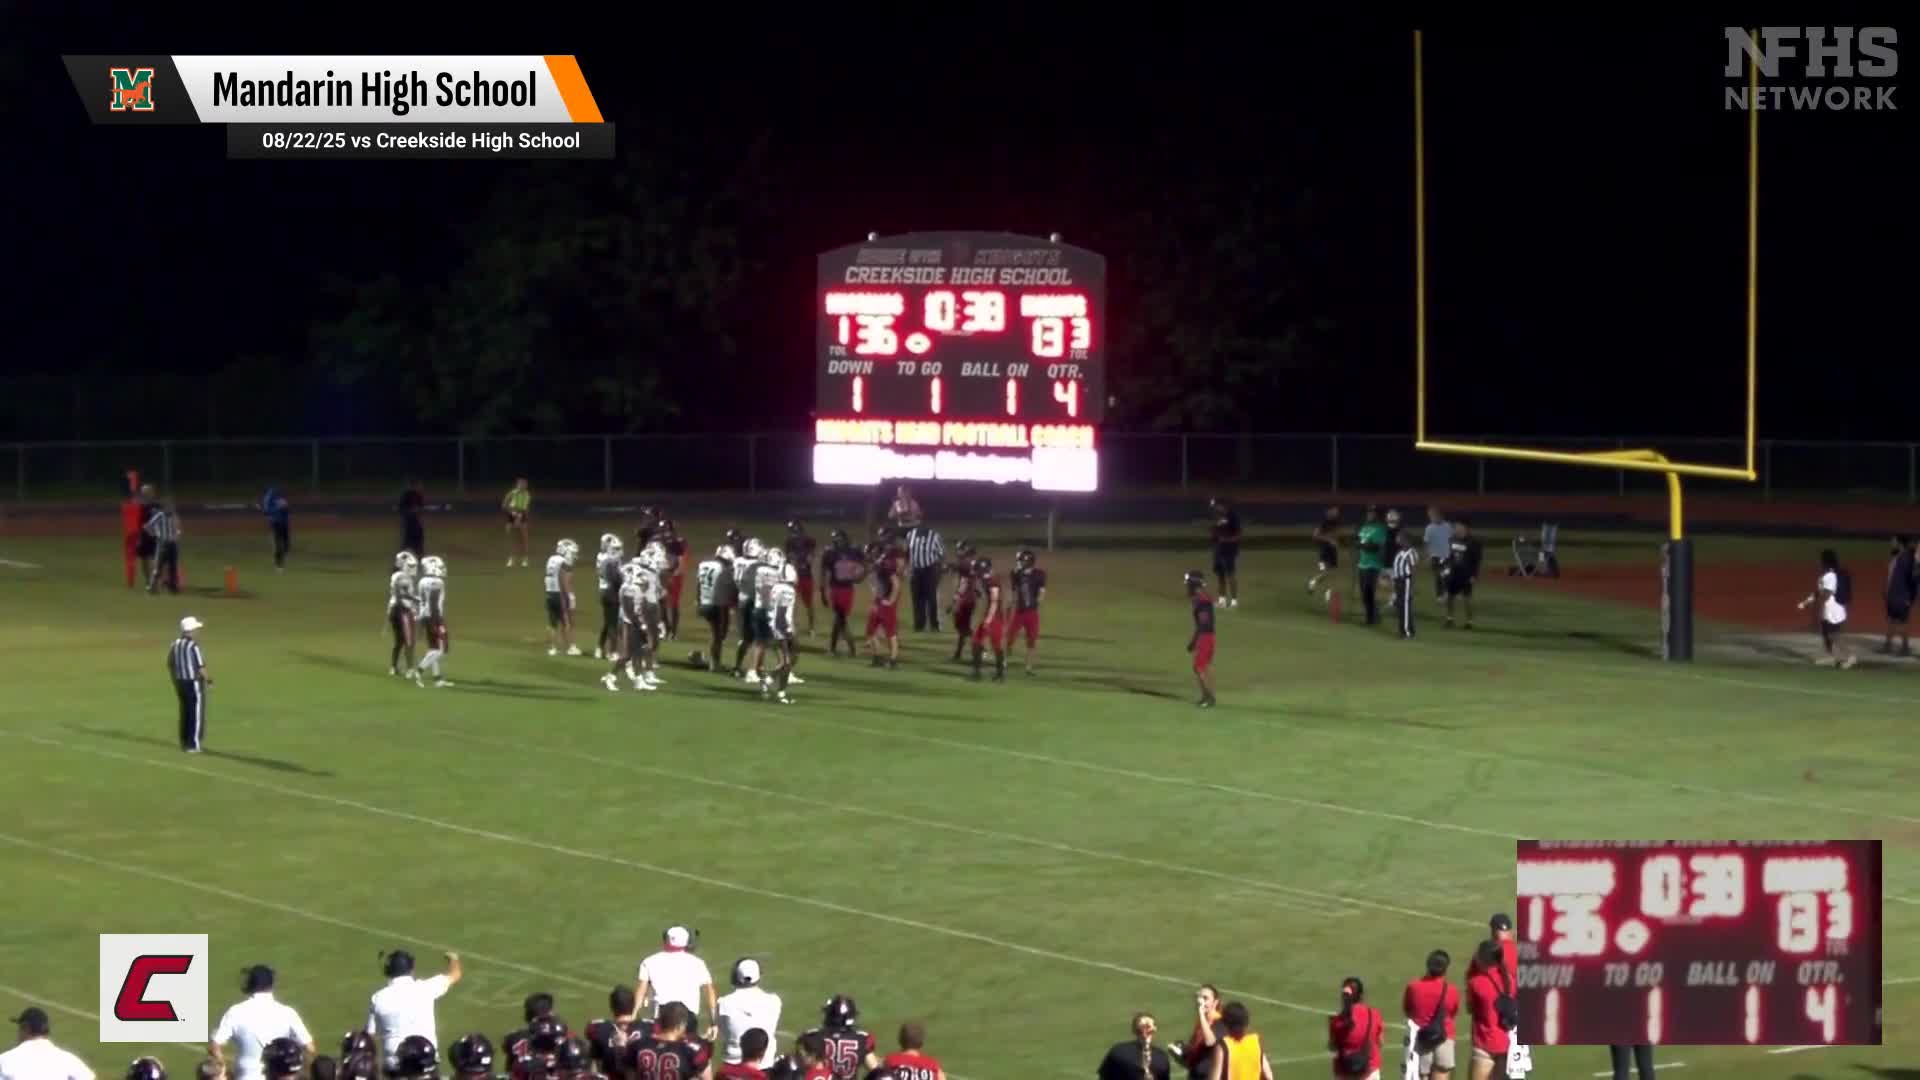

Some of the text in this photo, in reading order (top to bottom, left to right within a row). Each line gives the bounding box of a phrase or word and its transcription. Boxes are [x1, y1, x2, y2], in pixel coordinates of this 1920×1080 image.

[845, 267, 1072, 285] CREEKSIDE HIGH SCHOOL
[828, 362, 872, 374] DOWN
[898, 362, 942, 375] TO GO
[961, 362, 1028, 377] BALL ON
[1048, 364, 1083, 378] QTR.
[853, 376, 862, 412] 1
[932, 376, 941, 414] 1
[1007, 378, 1016, 415] 1
[1054, 380, 1077, 416] 4
